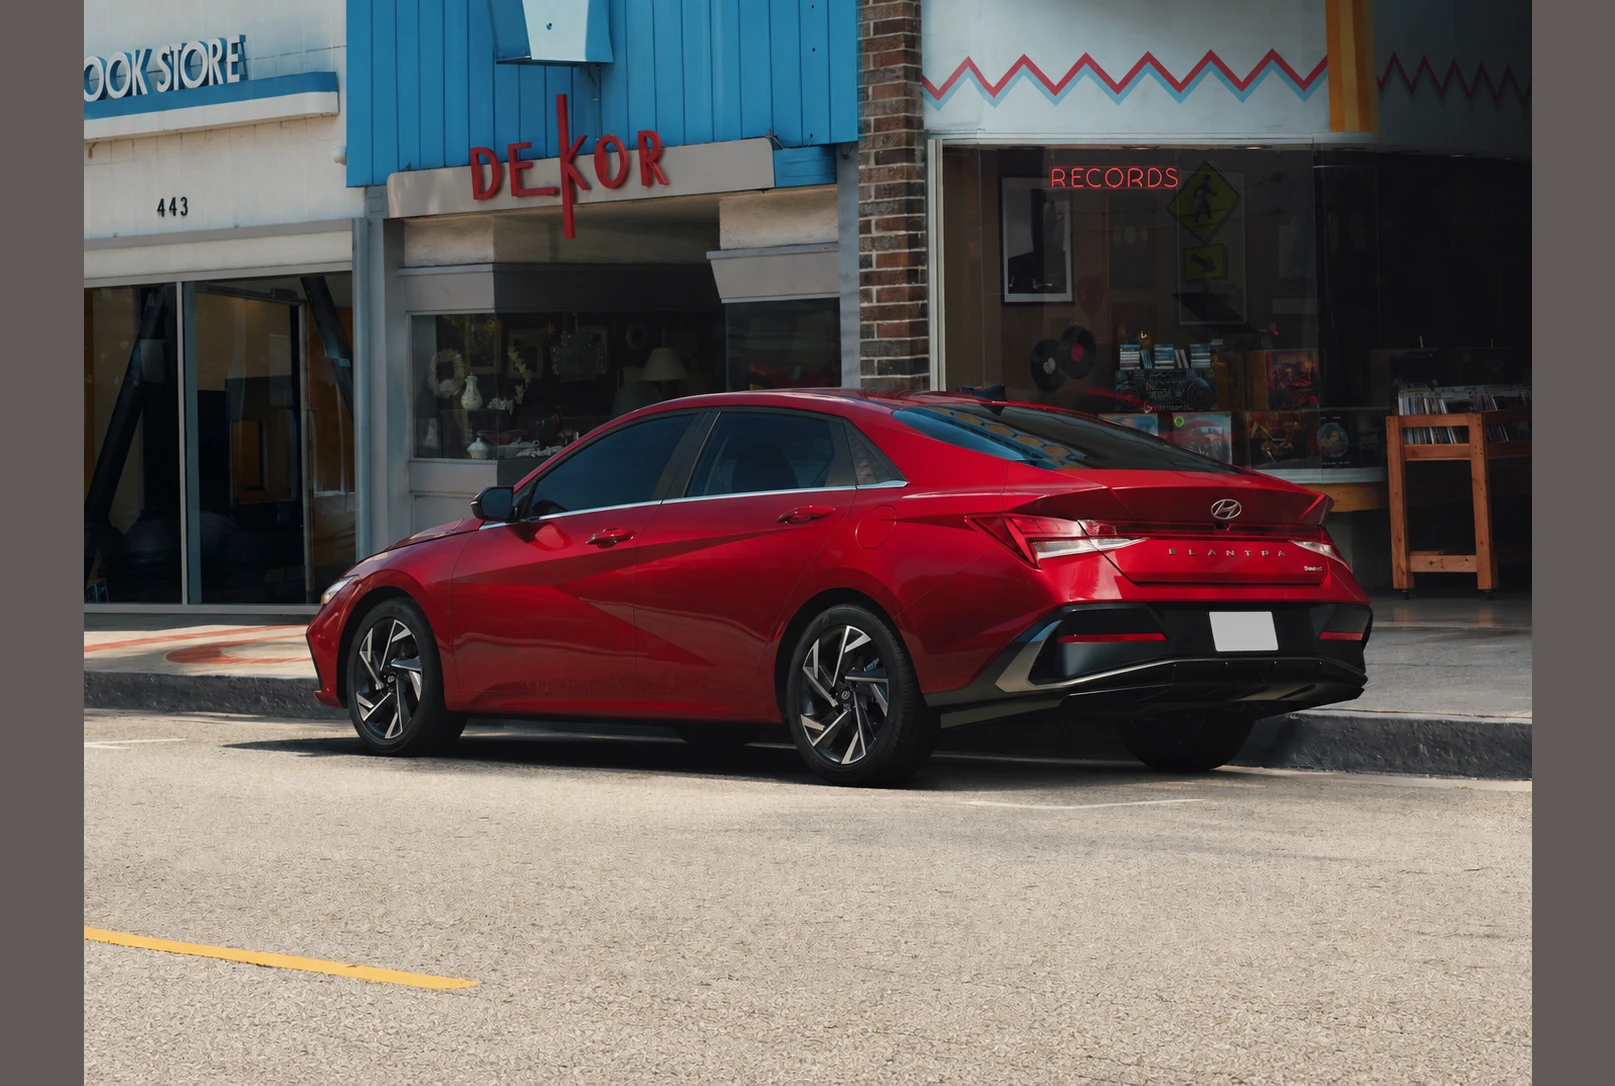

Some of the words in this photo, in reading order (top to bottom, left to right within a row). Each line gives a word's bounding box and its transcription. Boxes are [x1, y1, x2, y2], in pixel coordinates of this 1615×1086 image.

[84, 48, 152, 102] OOK
[156, 35, 246, 93] STORE
[470, 94, 670, 239] DEKOR
[1050, 167, 1180, 189] RECORDS
[156, 196, 189, 218] 443
[1168, 548, 1287, 557] ELANTRA
